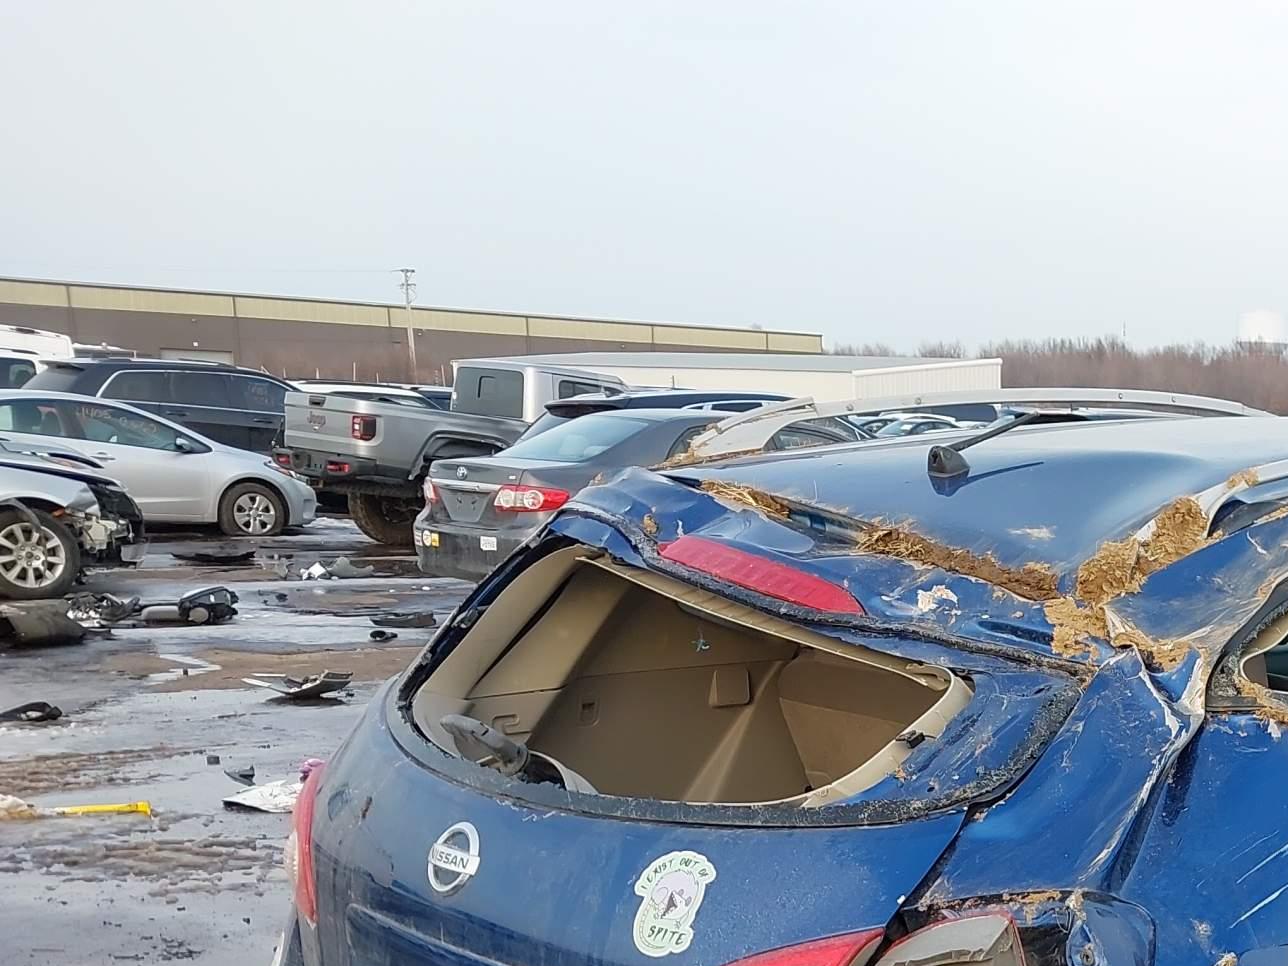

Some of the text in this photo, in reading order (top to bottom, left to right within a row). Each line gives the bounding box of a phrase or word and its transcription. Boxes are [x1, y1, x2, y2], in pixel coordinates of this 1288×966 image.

[646, 858, 675, 883] EXIST
[679, 857, 701, 868] OUT
[647, 925, 687, 945] SPITE
